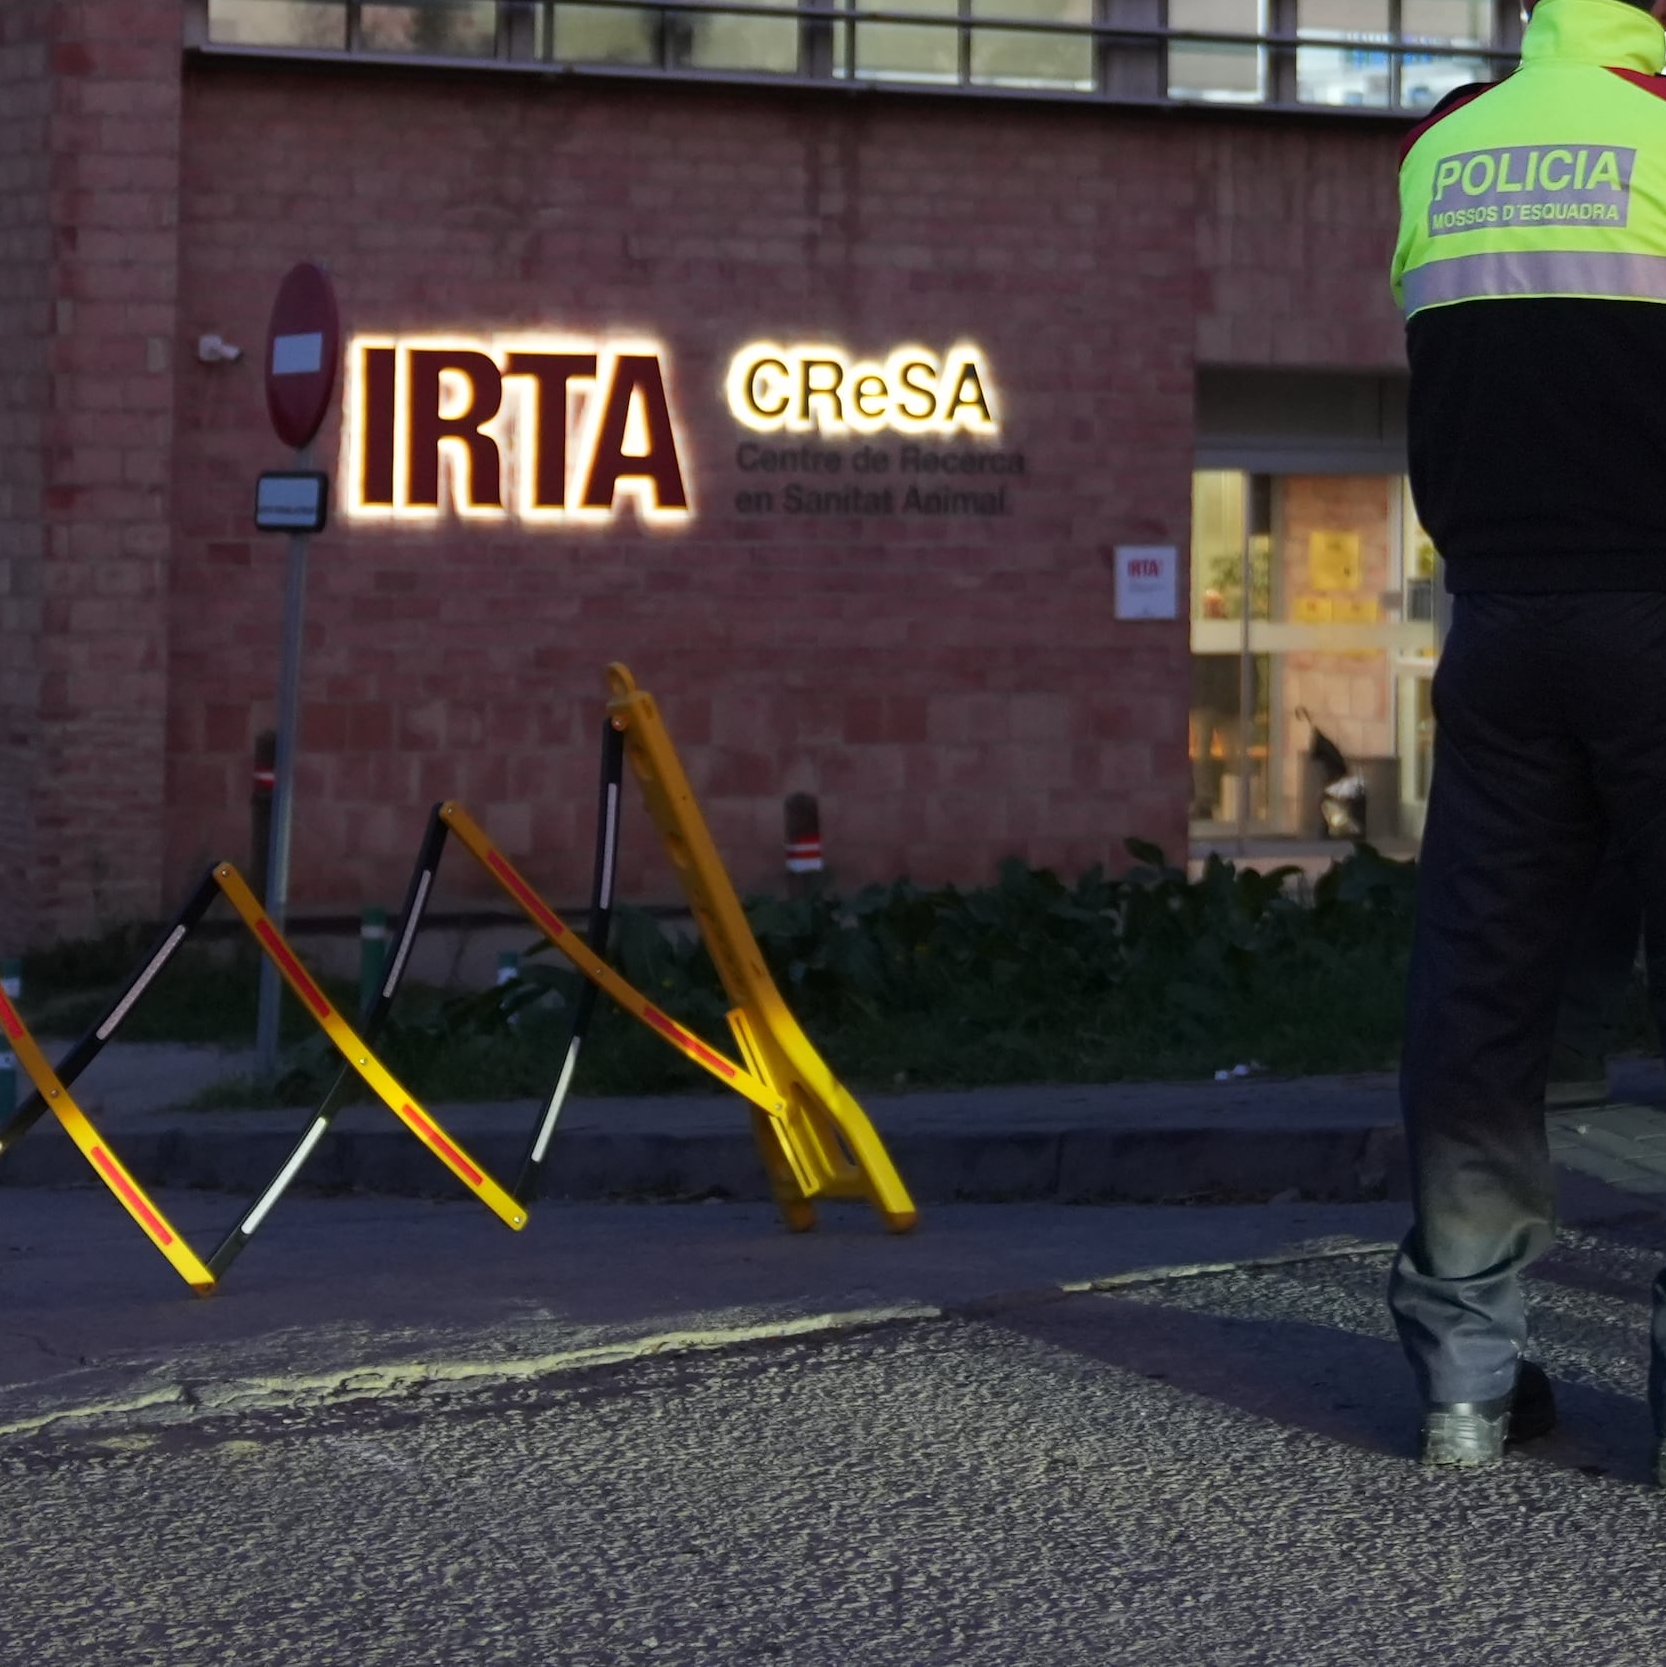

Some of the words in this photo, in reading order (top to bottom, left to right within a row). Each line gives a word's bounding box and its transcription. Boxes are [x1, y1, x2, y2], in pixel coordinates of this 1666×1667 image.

[1434, 148, 1623, 201] POLICIA
[1432, 205, 1499, 230] MOSSOS
[745, 358, 993, 422] CReSA
[362, 347, 689, 512] IRTA
[735, 443, 843, 474] Centre
[850, 444, 889, 474] de
[900, 444, 1026, 476] Recerca
[734, 489, 773, 514] en
[783, 482, 895, 514] Sanitat
[900, 482, 1006, 516] Animal
